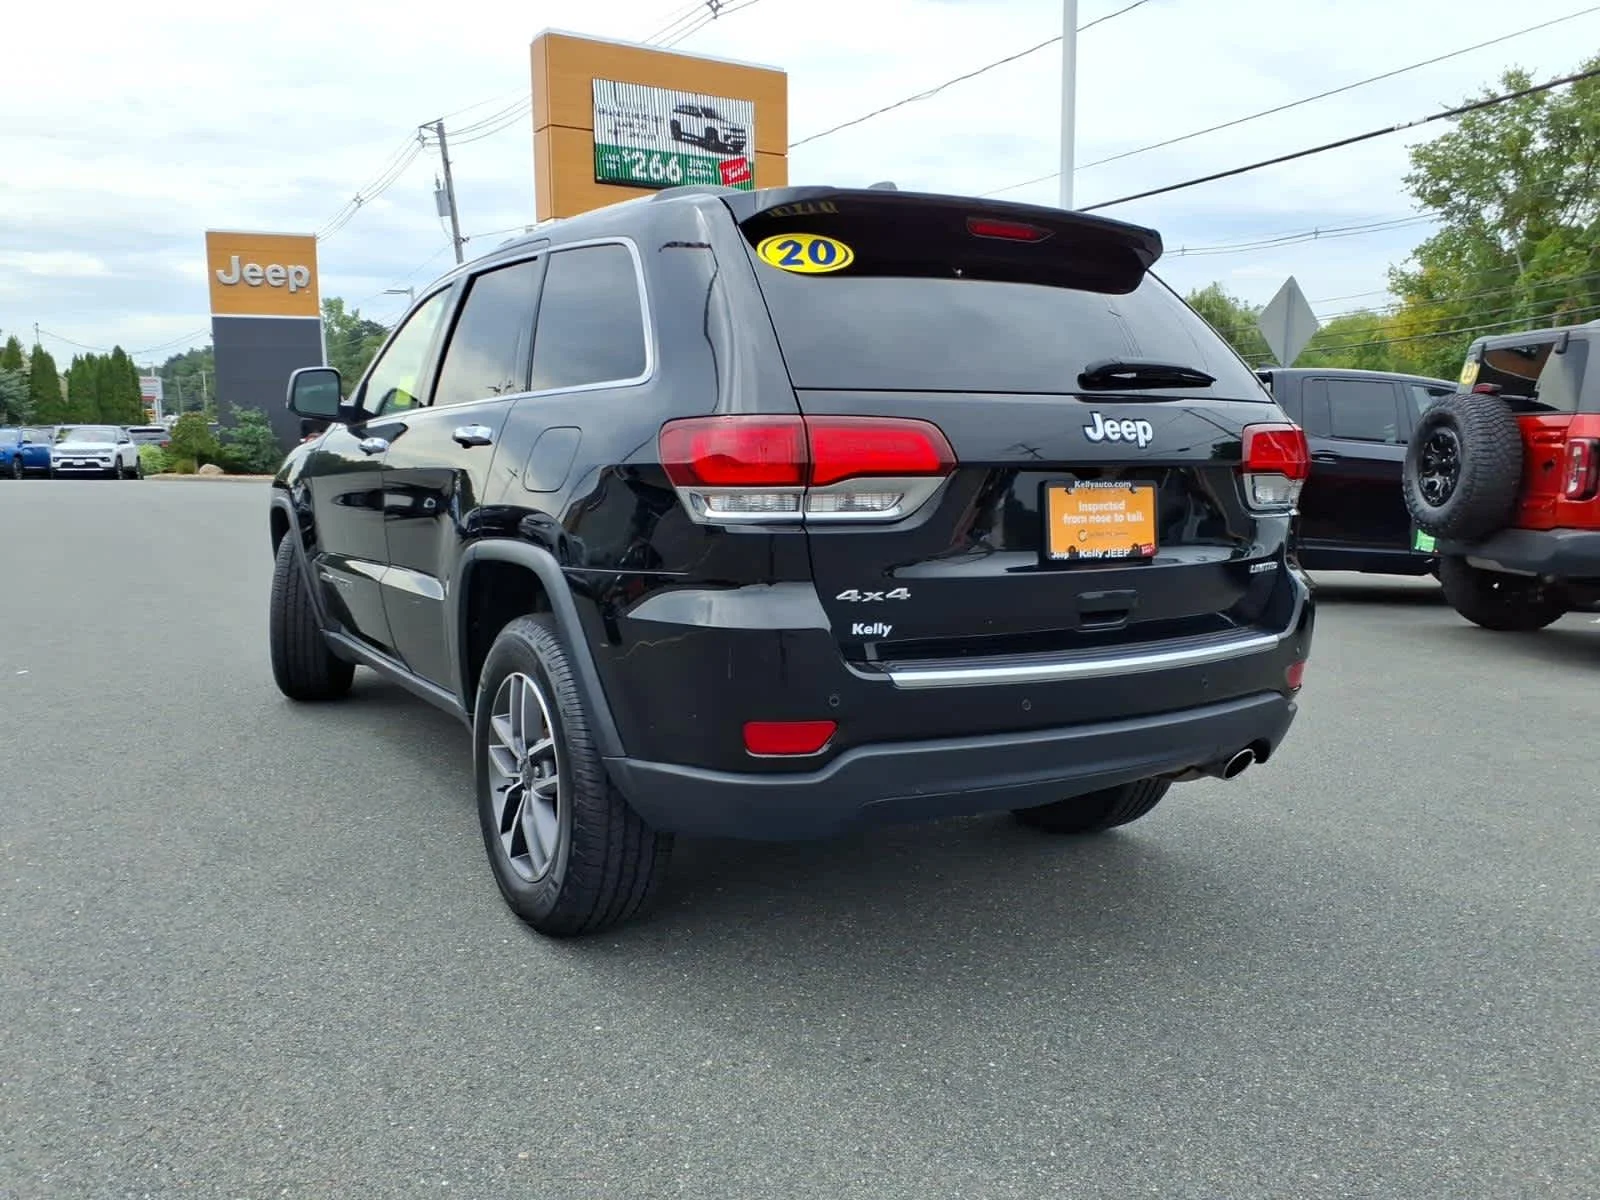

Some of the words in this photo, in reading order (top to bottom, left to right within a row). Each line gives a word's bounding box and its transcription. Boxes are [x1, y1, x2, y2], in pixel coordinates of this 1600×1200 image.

[622, 150, 683, 183] $266
[776, 239, 836, 266] 20
[216, 255, 310, 293] Jeep
[1083, 411, 1153, 449] Jeep
[1074, 480, 1132, 489] Kellyauto.com
[1063, 513, 1087, 525] from
[1113, 512, 1125, 522] to
[1079, 549, 1104, 559] Kelly
[1105, 548, 1131, 558] JEEP
[835, 587, 912, 602] 4x4
[851, 623, 893, 638] Kelly
